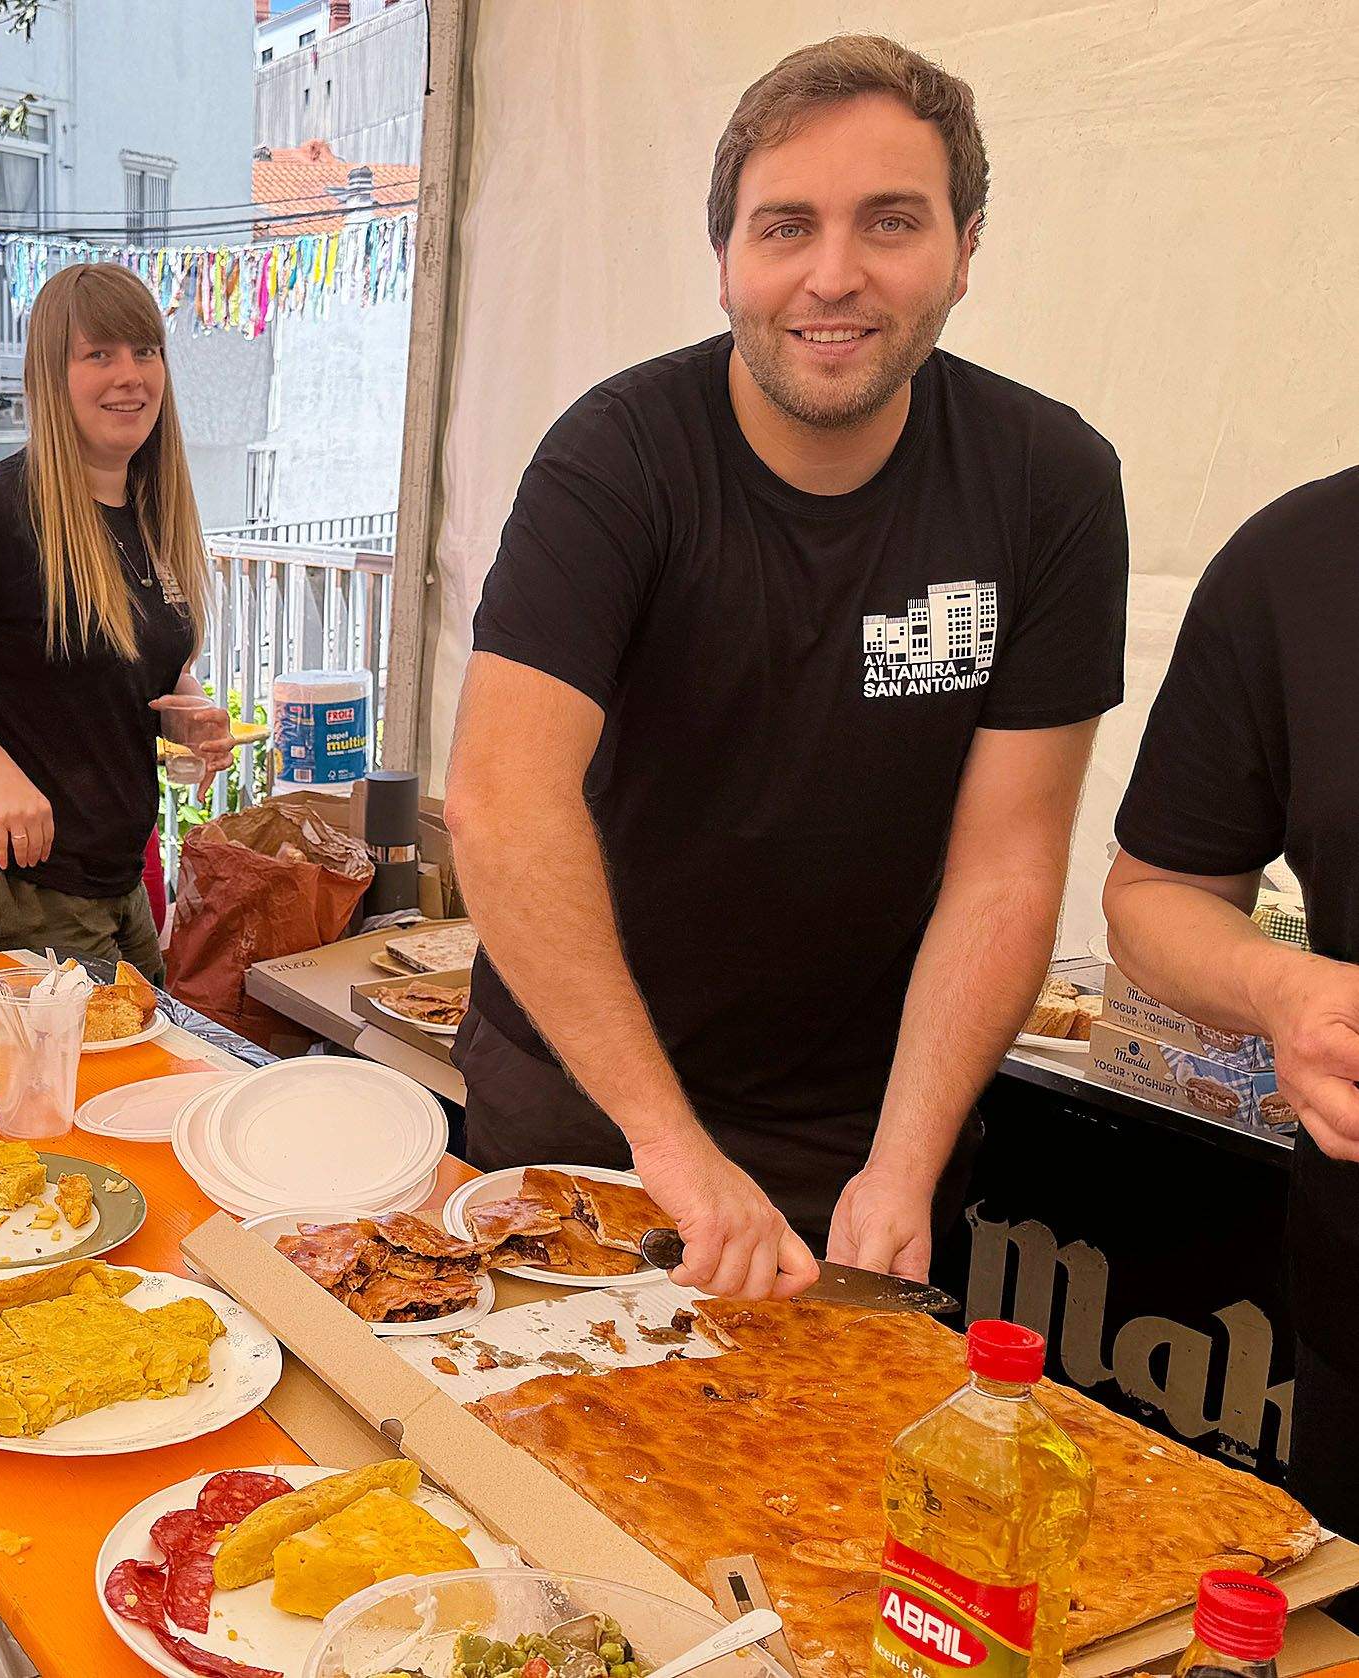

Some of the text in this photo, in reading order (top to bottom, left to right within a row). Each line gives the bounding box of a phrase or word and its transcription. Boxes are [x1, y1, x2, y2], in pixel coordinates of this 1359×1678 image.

[863, 653, 886, 667] A.V.
[863, 661, 955, 682] ALTAMIRA
[863, 669, 990, 698] SAN ANTONIÑO
[327, 709, 354, 722] FROIZ
[326, 731, 349, 742] papel
[1107, 998, 1187, 1034] YOGUR YOGHURT
[1114, 1046, 1151, 1072] Mandul
[1093, 1057, 1126, 1079] YOGUR
[1131, 1071, 1178, 1097] YOGHURT
[881, 1591, 972, 1665] ABRIL
